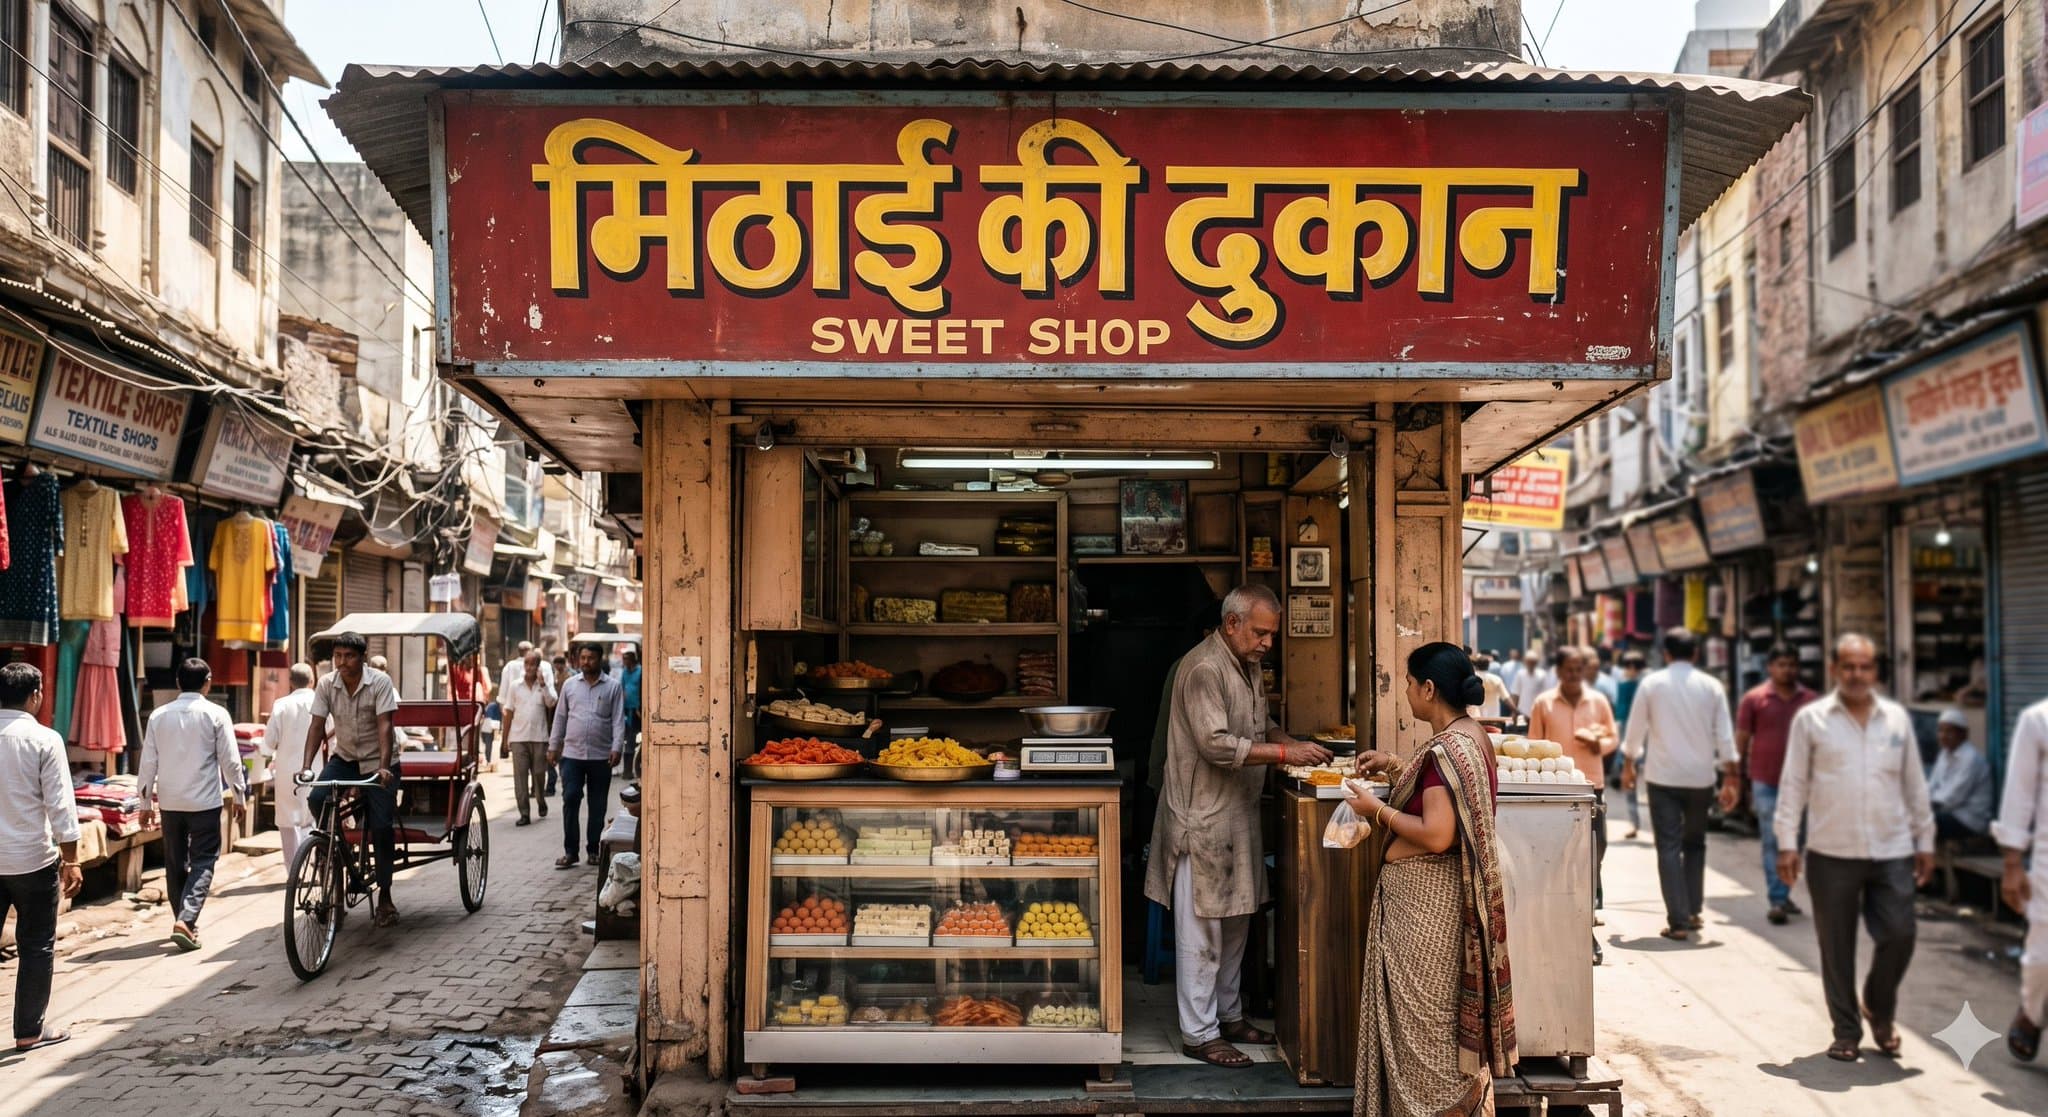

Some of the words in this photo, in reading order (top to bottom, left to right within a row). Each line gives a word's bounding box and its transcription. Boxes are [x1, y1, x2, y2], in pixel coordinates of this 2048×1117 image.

[532, 117, 955, 313] मिठाई
[978, 119, 1142, 293] की
[1164, 166, 1580, 341] दुकान
[811, 317, 1005, 355] SWEET
[1028, 317, 1171, 356] SHOP
[55, 356, 130, 419] TEXTILE
[132, 389, 184, 436] SHOPS
[67, 408, 119, 440] TEXTILE
[121, 427, 158, 451] SHOPS
